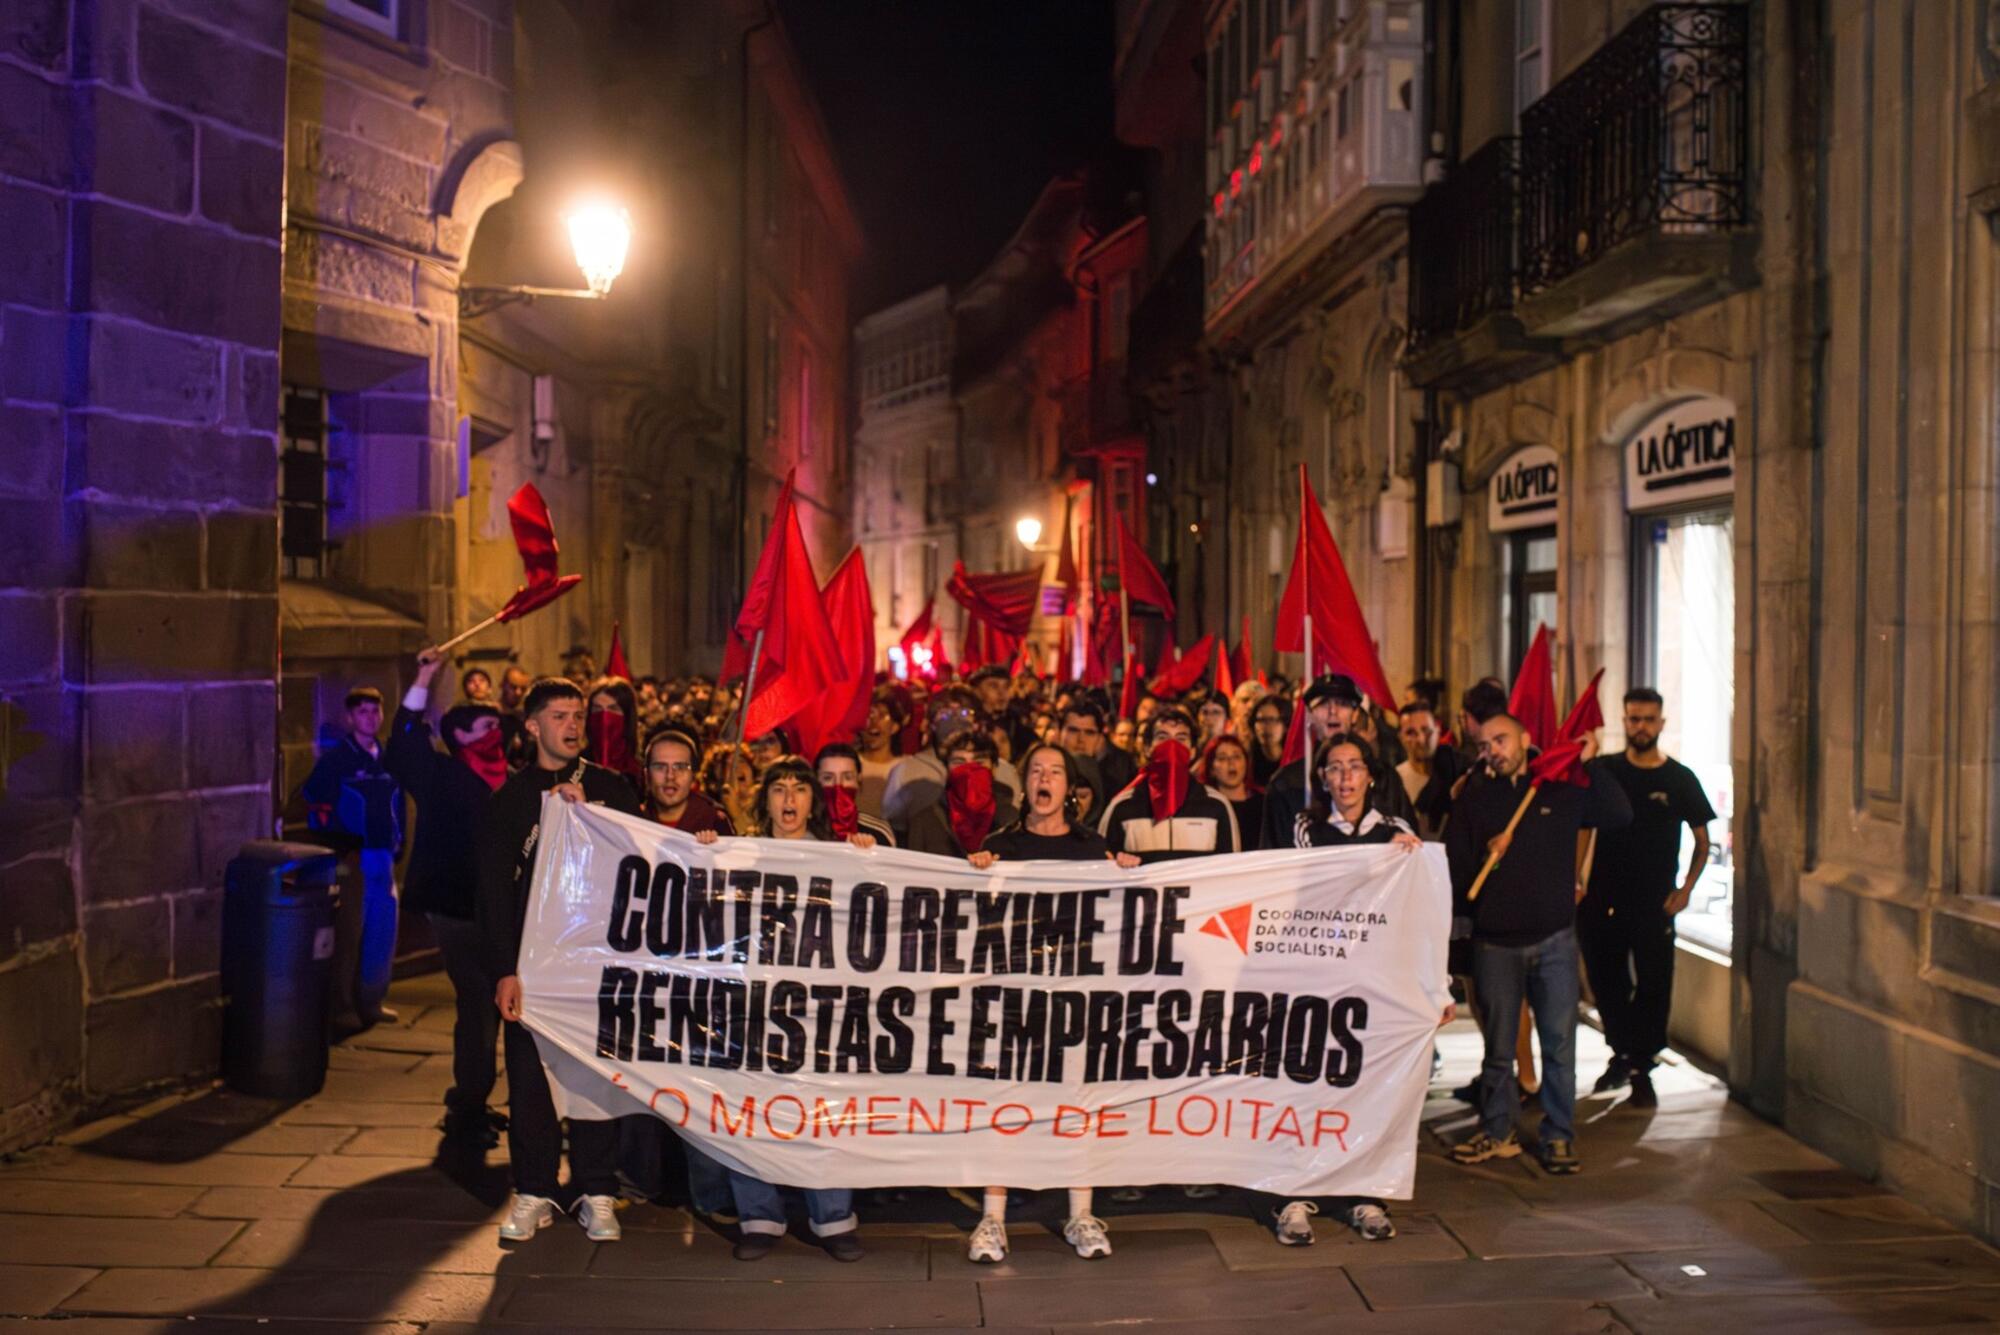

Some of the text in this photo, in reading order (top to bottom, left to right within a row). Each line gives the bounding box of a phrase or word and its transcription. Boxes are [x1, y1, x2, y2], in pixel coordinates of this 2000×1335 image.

[1638, 434, 1662, 476] LA
[1497, 461, 1557, 504] LA ÓPTIC
[607, 854, 1190, 977] CONTRA O REXIME DE
[1255, 924, 1369, 942] DA MOCIDADE
[1258, 908, 1388, 926] COORDINADORA
[1254, 941, 1347, 960] SOCIALISTA
[596, 966, 1368, 1089] RENDISTAS E EMPRESARIOS
[709, 1092, 1034, 1140] MOMENTO
[1051, 1104, 1129, 1138] DE
[1147, 1094, 1352, 1152] LOITAR
